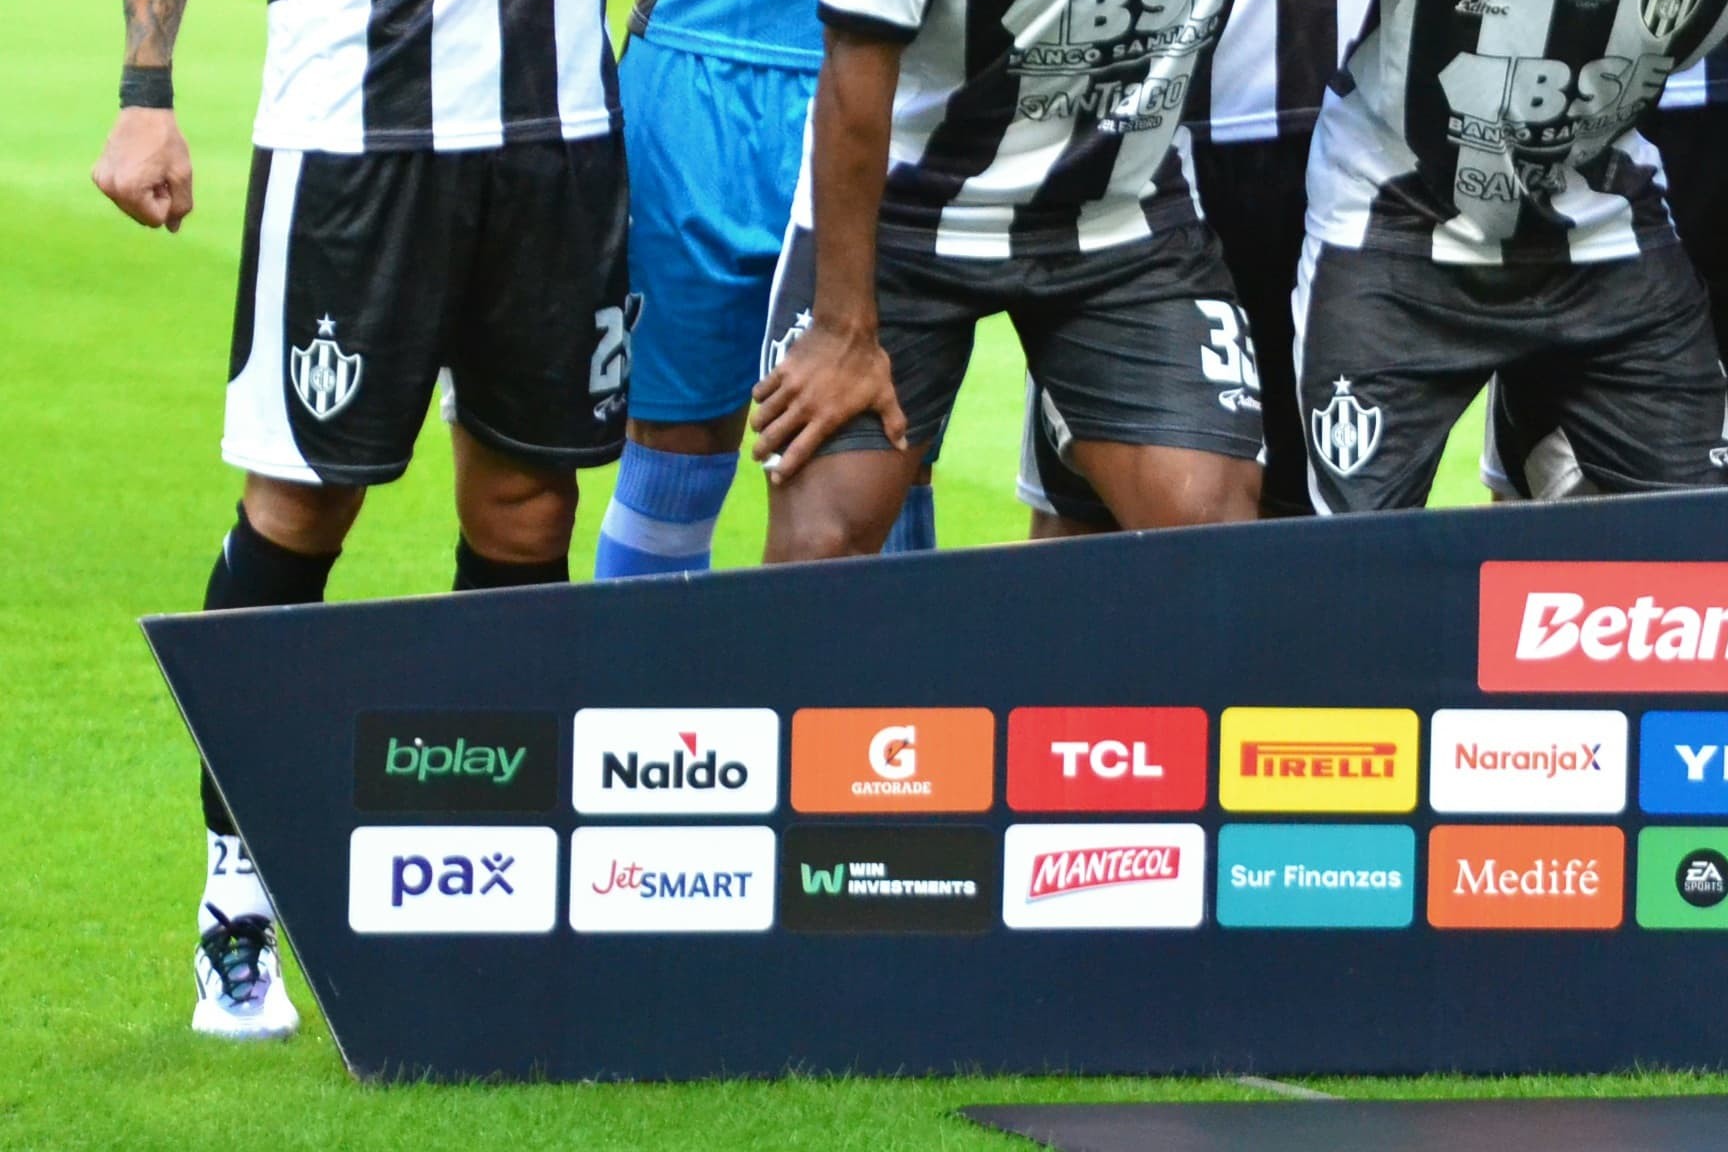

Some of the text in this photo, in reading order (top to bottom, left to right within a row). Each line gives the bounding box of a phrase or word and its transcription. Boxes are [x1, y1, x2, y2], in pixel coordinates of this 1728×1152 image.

[1503, 53, 1676, 127] BSE
[385, 737, 527, 782] bplay
[601, 732, 748, 791] Naldo
[1051, 740, 1162, 778] TCL
[1240, 741, 1397, 778] PIRELLI
[851, 781, 931, 796] GATORADE
[390, 851, 516, 906] pax
[848, 878, 977, 896] INVESTMENTS
[849, 862, 885, 876] WIN
[1033, 848, 1173, 893] MANTECOL
[1230, 863, 1402, 889] Sur Finanzas
[1453, 857, 1599, 897] Medifé
[1684, 880, 1724, 892] SPORTS
[1685, 861, 1723, 881] EA
